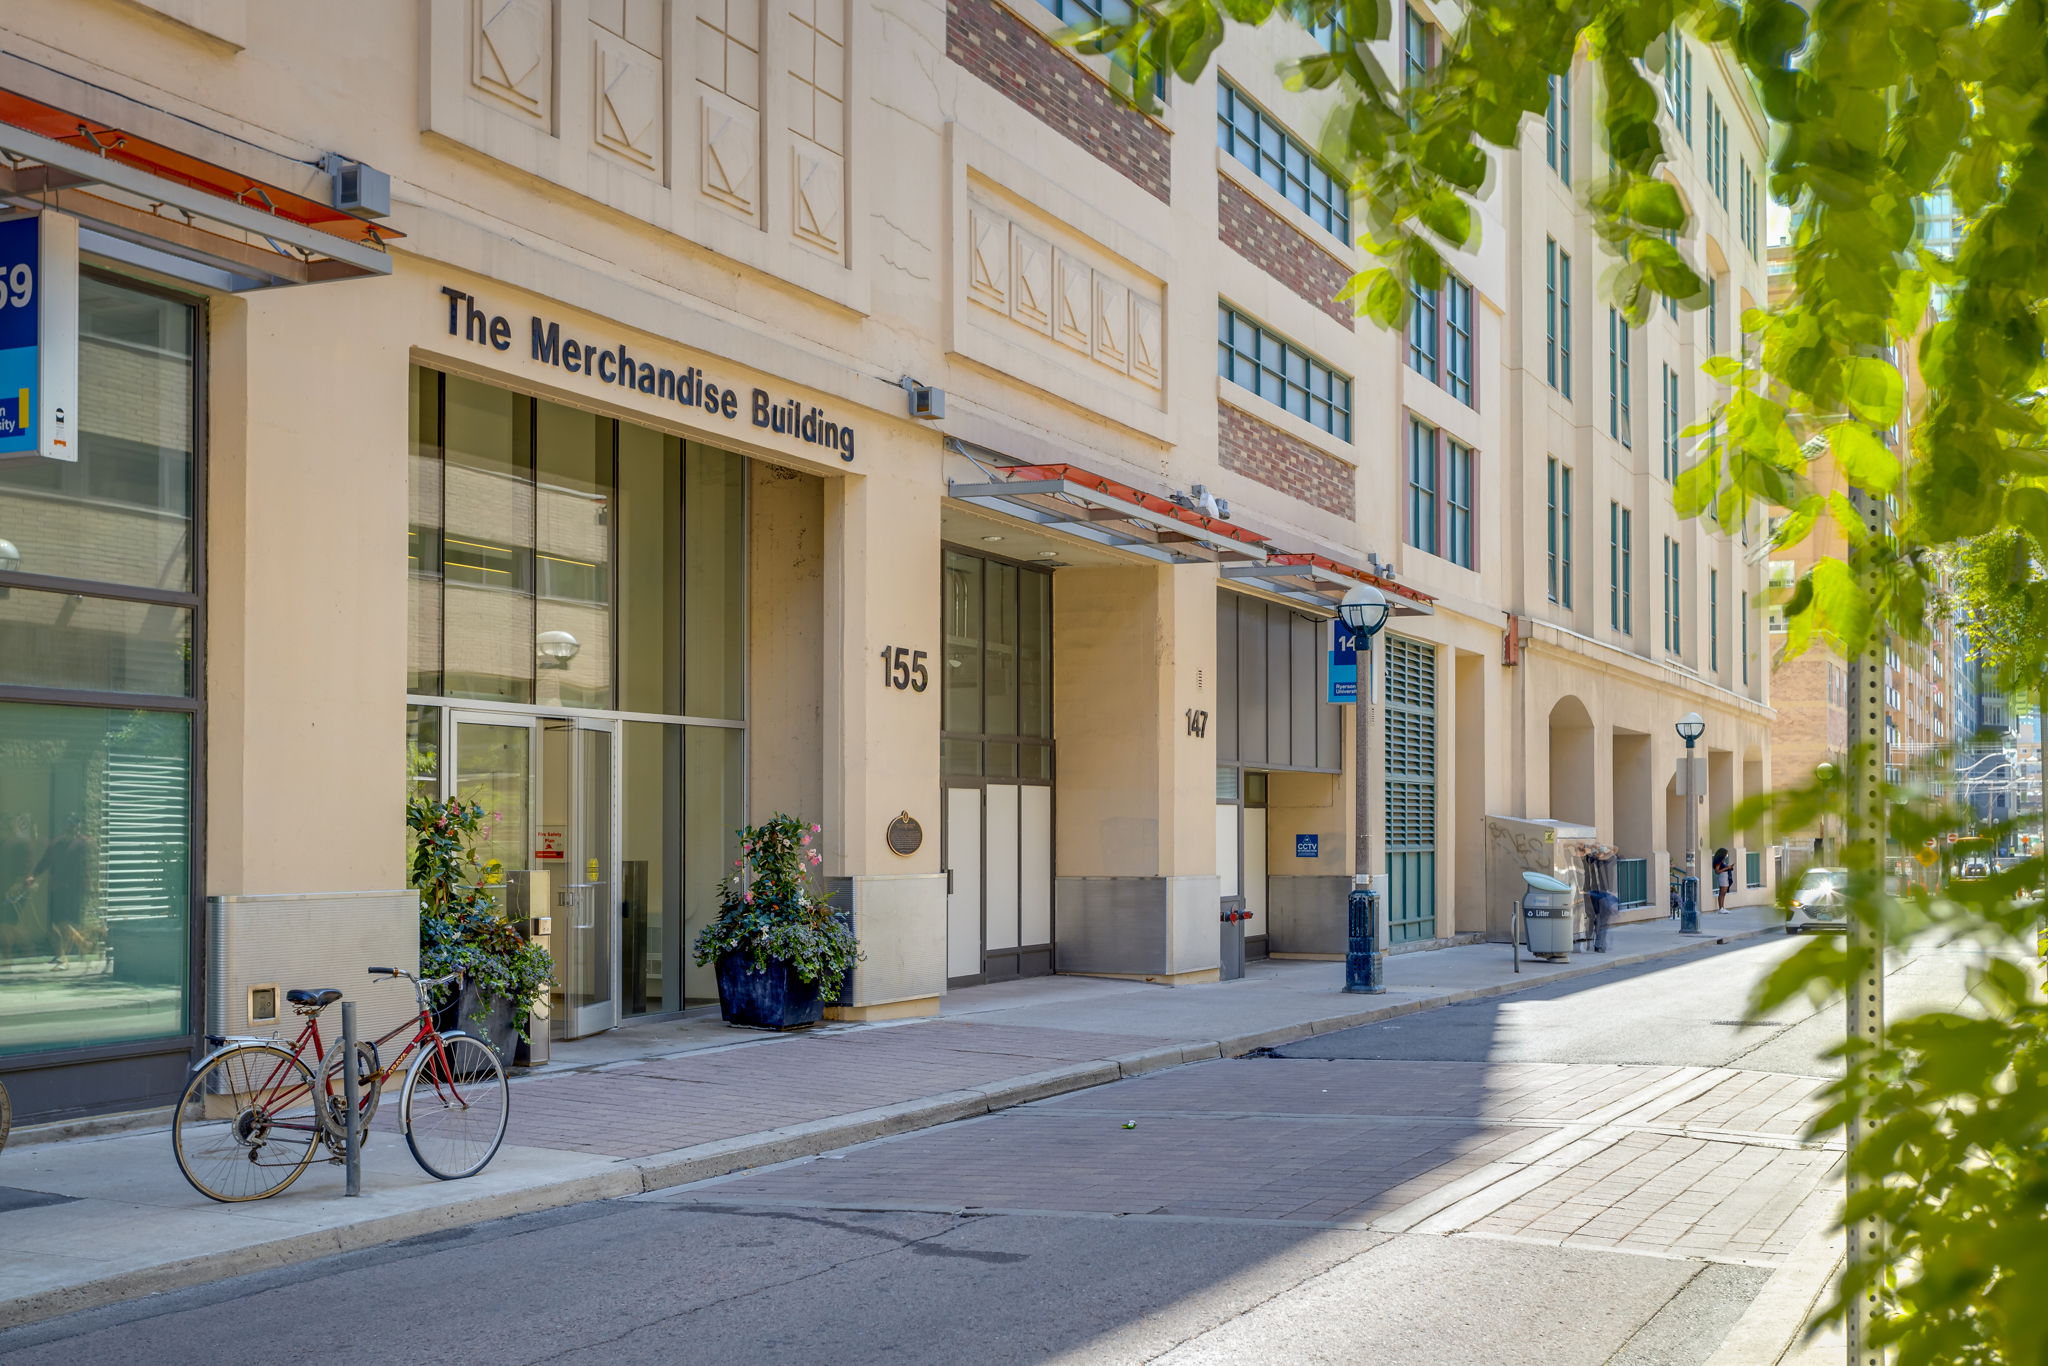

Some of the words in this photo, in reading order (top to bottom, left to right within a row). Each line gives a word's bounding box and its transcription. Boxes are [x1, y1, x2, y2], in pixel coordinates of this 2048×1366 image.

[440, 286, 512, 351] The
[531, 316, 738, 419] Merchandise
[752, 388, 855, 462] Building
[880, 645, 928, 692] 155
[1185, 708, 1208, 739] 147
[388, 1053, 408, 1075] ARAYA
